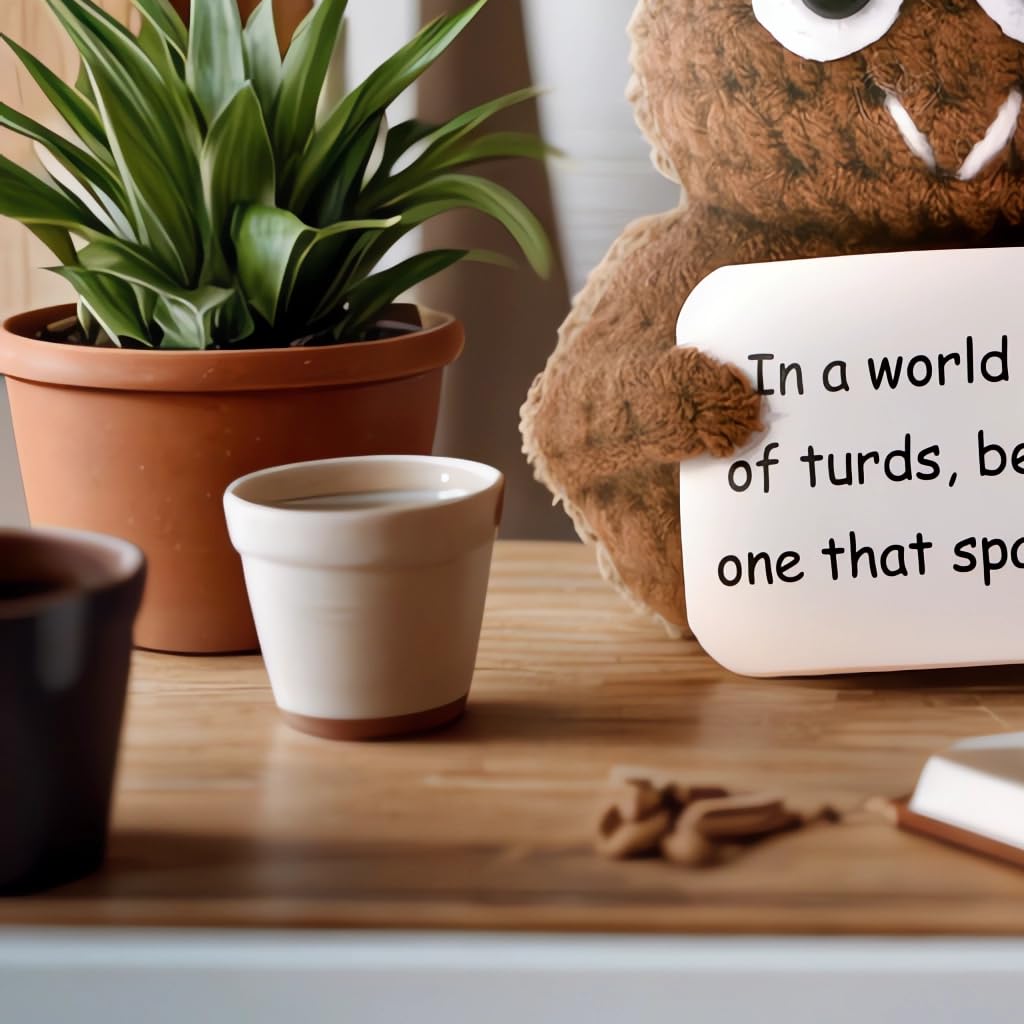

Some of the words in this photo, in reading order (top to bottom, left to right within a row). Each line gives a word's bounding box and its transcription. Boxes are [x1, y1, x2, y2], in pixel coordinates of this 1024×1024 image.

[747, 353, 804, 396] In
[822, 360, 850, 393] a
[867, 335, 1010, 391] world
[727, 442, 780, 494] of
[799, 432, 958, 488] turds,
[717, 550, 805, 587] one
[821, 530, 933, 581] that
